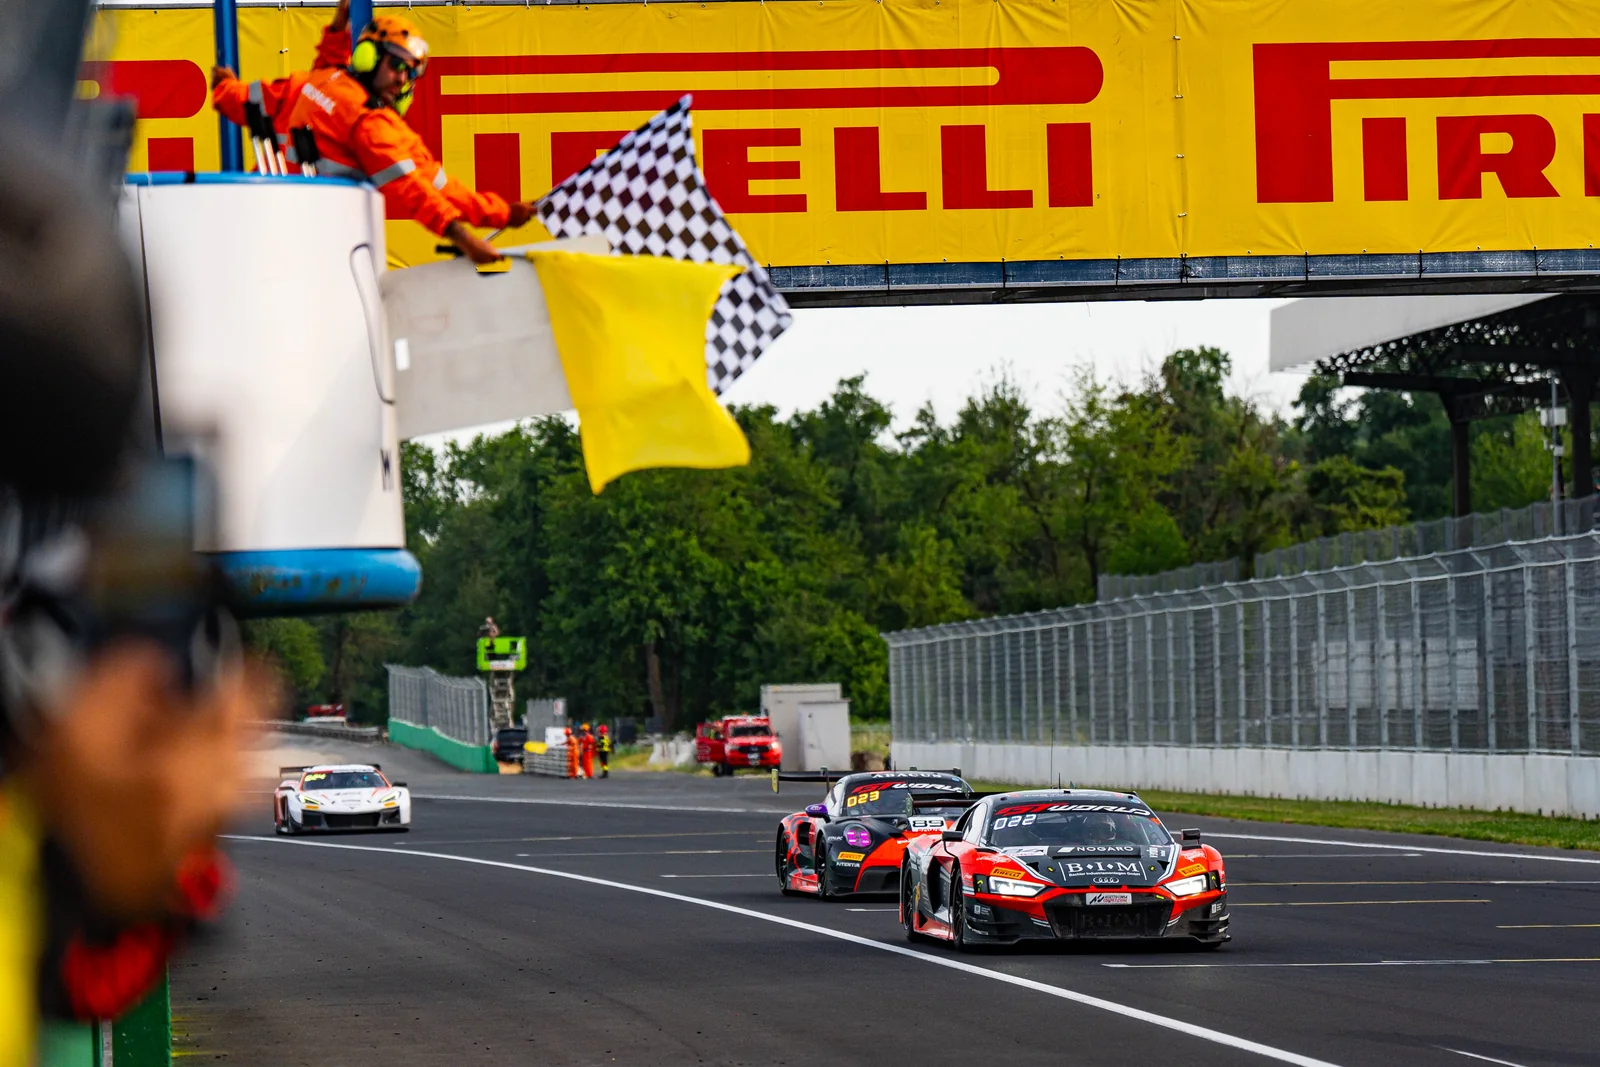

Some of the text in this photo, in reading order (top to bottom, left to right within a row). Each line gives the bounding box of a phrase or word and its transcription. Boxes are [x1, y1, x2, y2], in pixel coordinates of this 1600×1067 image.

[1253, 37, 1600, 203] PIR
[847, 790, 880, 807] 023
[912, 820, 944, 828] 89
[993, 814, 1037, 830] 022
[992, 868, 1022, 878] PIRELLI
[1181, 863, 1205, 875] PIRELLI
